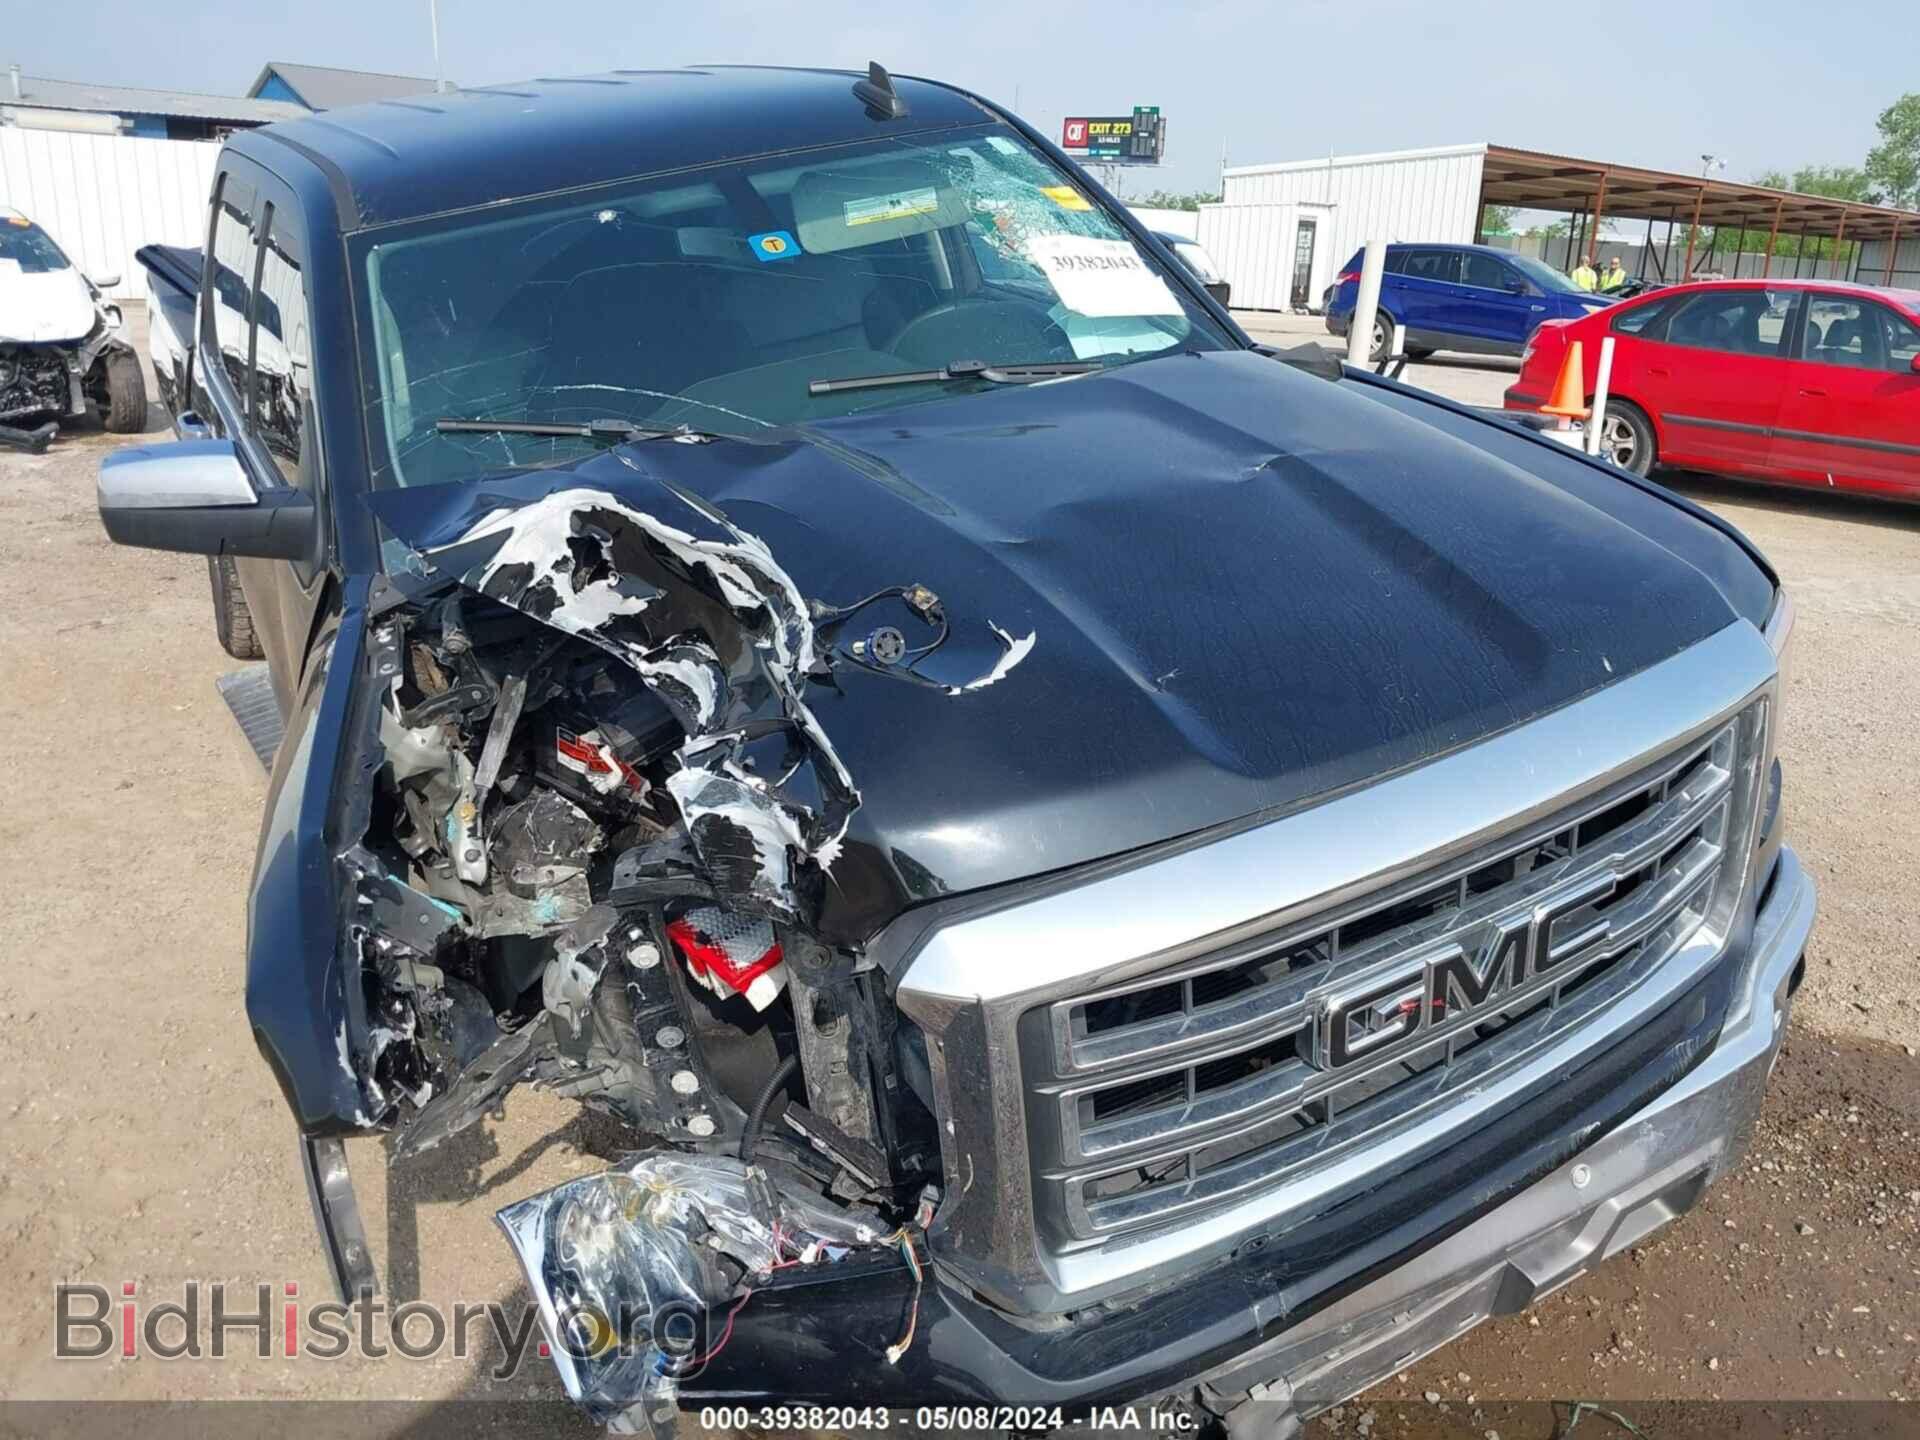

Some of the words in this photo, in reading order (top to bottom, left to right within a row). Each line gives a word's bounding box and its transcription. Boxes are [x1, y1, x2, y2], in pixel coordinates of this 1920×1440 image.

[1067, 124, 1084, 140] QT
[1089, 123, 1111, 134] EXIT
[1113, 123, 1131, 134] 273
[1051, 255, 1139, 272] 39382043
[1320, 869, 1617, 1072] GMC
